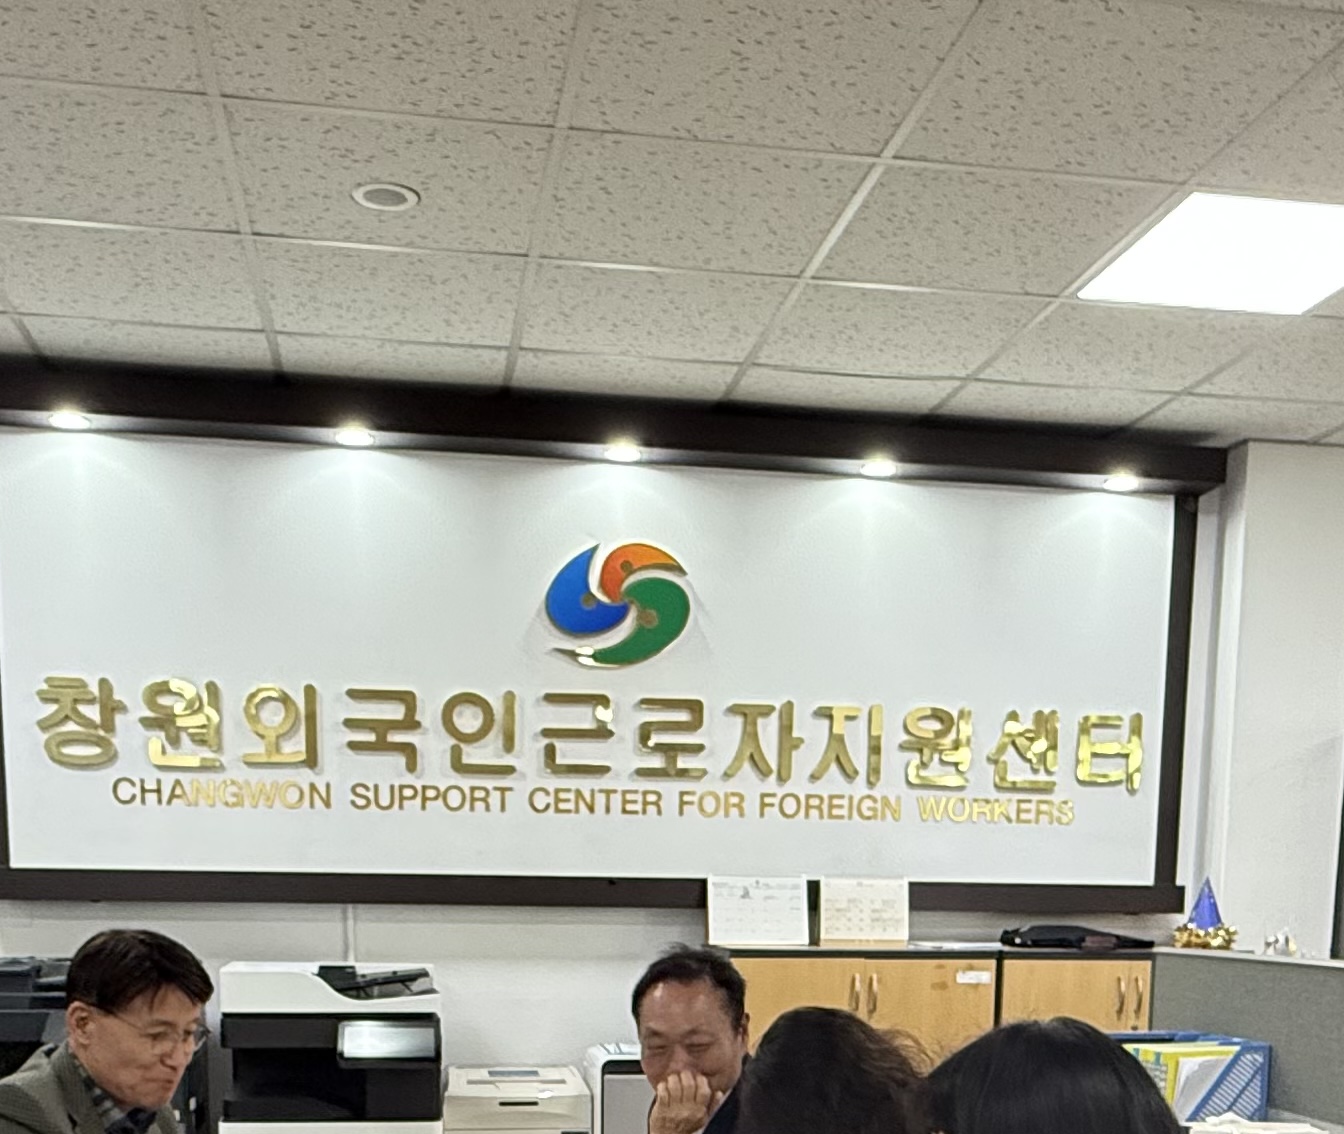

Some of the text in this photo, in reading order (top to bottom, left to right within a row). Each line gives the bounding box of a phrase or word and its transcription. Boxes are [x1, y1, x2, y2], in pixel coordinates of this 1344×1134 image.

[36, 676, 1143, 795] 창원외국인근로자지원센터
[111, 777, 1076, 826] CHANGWON SUPPORT CENTER FOR FOREIGN WORKERS
